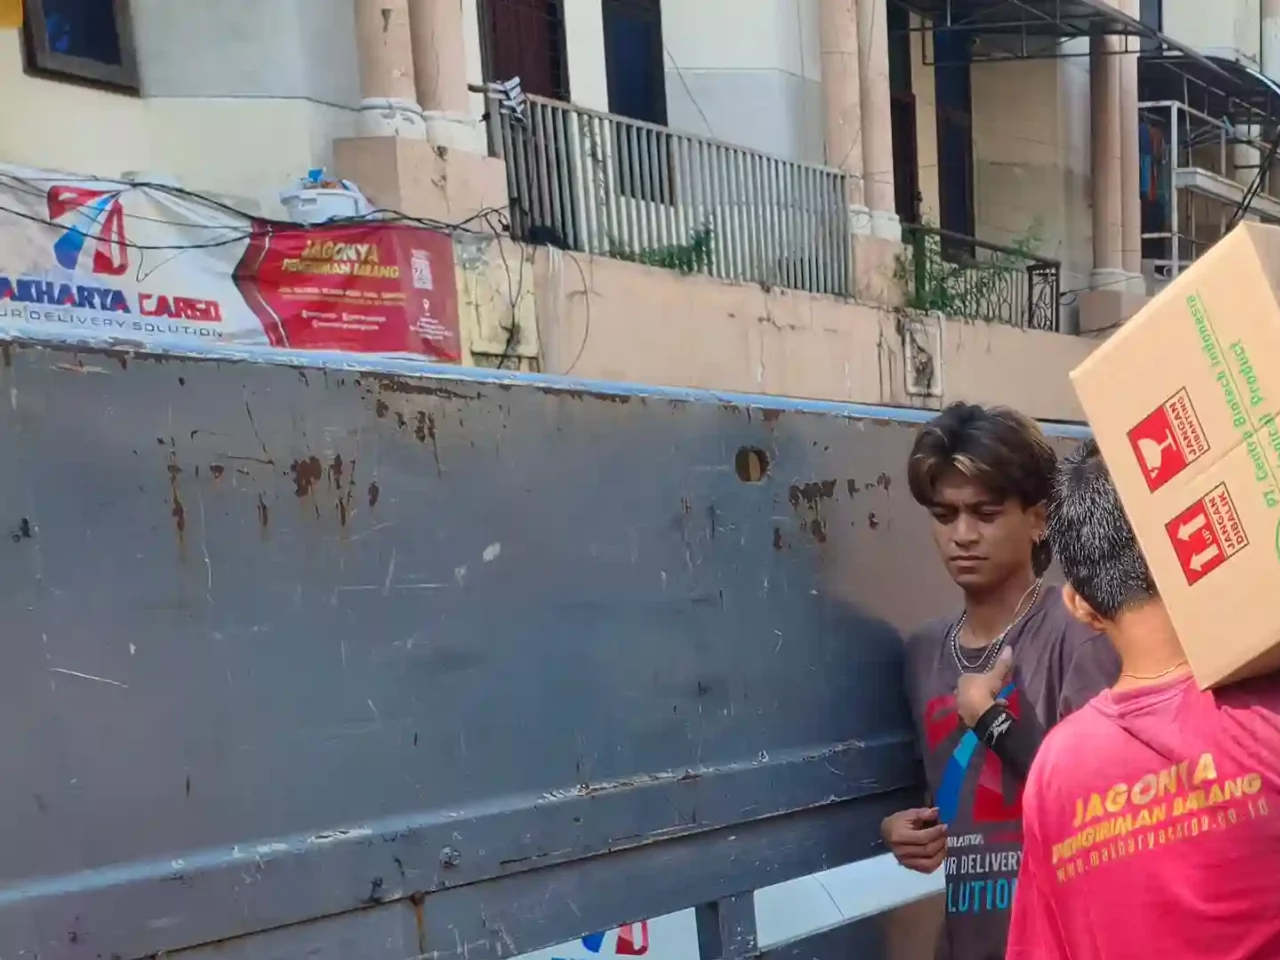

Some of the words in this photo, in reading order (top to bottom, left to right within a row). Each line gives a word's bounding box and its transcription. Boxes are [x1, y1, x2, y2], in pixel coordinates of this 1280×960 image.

[0, 276, 131, 314] AKHARYA
[0, 307, 22, 319] UR
[29, 311, 126, 328] DELIVERY
[132, 321, 223, 338] SOLUTION
[1228, 338, 1266, 406] Product
[1169, 401, 1197, 456] JANGAN
[1177, 396, 1204, 453] DIBANTING
[1202, 528, 1213, 544] UP
[1209, 496, 1236, 550] JANGAN
[1217, 490, 1245, 546] DIBALIK
[944, 856, 958, 876] UR
[947, 877, 1018, 913] LUTIO
